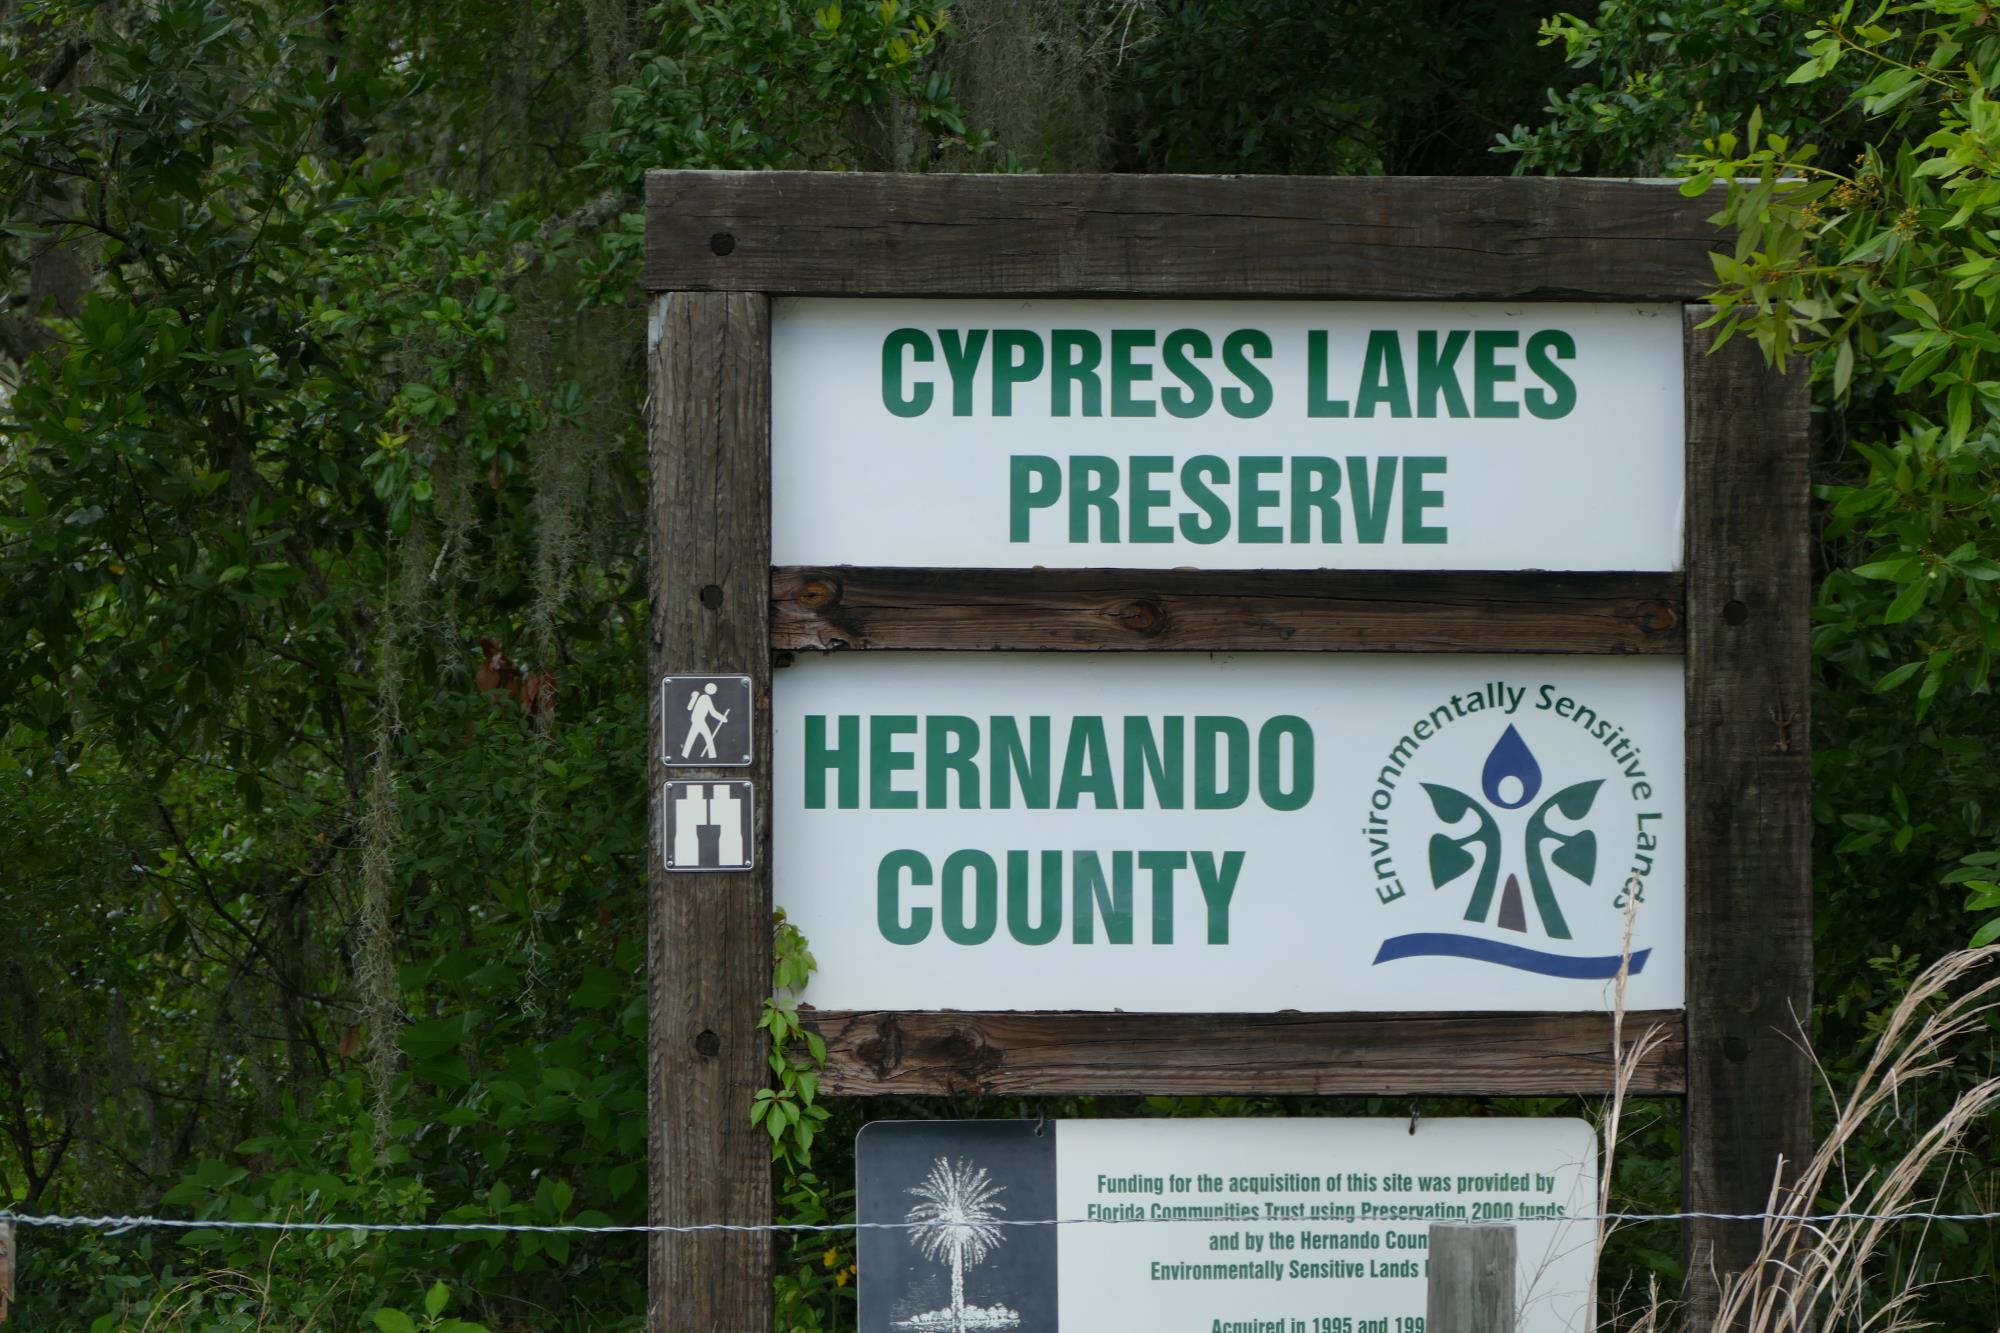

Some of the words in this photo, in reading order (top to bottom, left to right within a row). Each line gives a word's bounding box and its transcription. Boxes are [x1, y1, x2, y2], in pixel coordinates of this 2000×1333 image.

[881, 327, 1274, 419] CYPRESS
[1307, 329, 1578, 420] LAKES
[1009, 454, 1448, 545] PRESERVE
[804, 714, 1315, 812] HERNANDO
[1362, 681, 1527, 905] Environmentally
[1535, 683, 1653, 801] Sensitive
[1613, 812, 1663, 914] Lands
[876, 848, 1247, 947] COUNTY
[1087, 1203, 1146, 1221] Florida
[1150, 1203, 1260, 1222] Communities
[1264, 1202, 1305, 1221] Trust
[1310, 1202, 1356, 1223] using
[1361, 1202, 1467, 1221] Preservation
[1472, 1202, 1514, 1221] 2000
[1519, 1202, 1566, 1221] funds
[1097, 1174, 1164, 1196] Funding
[1169, 1174, 1192, 1194] for
[1197, 1174, 1224, 1193] the
[1229, 1173, 1321, 1195] acquisition
[1326, 1174, 1342, 1193] of
[1347, 1173, 1378, 1192] this
[1382, 1173, 1413, 1192] site
[1418, 1175, 1452, 1192] was
[1457, 1173, 1530, 1194] provided
[1535, 1173, 1555, 1194] by
[1209, 1231, 1240, 1251] and
[1245, 1231, 1265, 1252] by
[1269, 1231, 1296, 1250] the
[1300, 1230, 1380, 1250] Hernando
[1386, 1230, 1430, 1249] Coun
[1150, 1260, 1285, 1281] Environmentally
[1289, 1259, 1365, 1279] Sensitive
[1370, 1259, 1420, 1278] Lands
[1211, 1318, 1286, 1333] Acquired
[1291, 1318, 1307, 1333] in
[1312, 1317, 1352, 1333] 1995
[1358, 1317, 1389, 1333] and
[1395, 1317, 1426, 1333] 199
